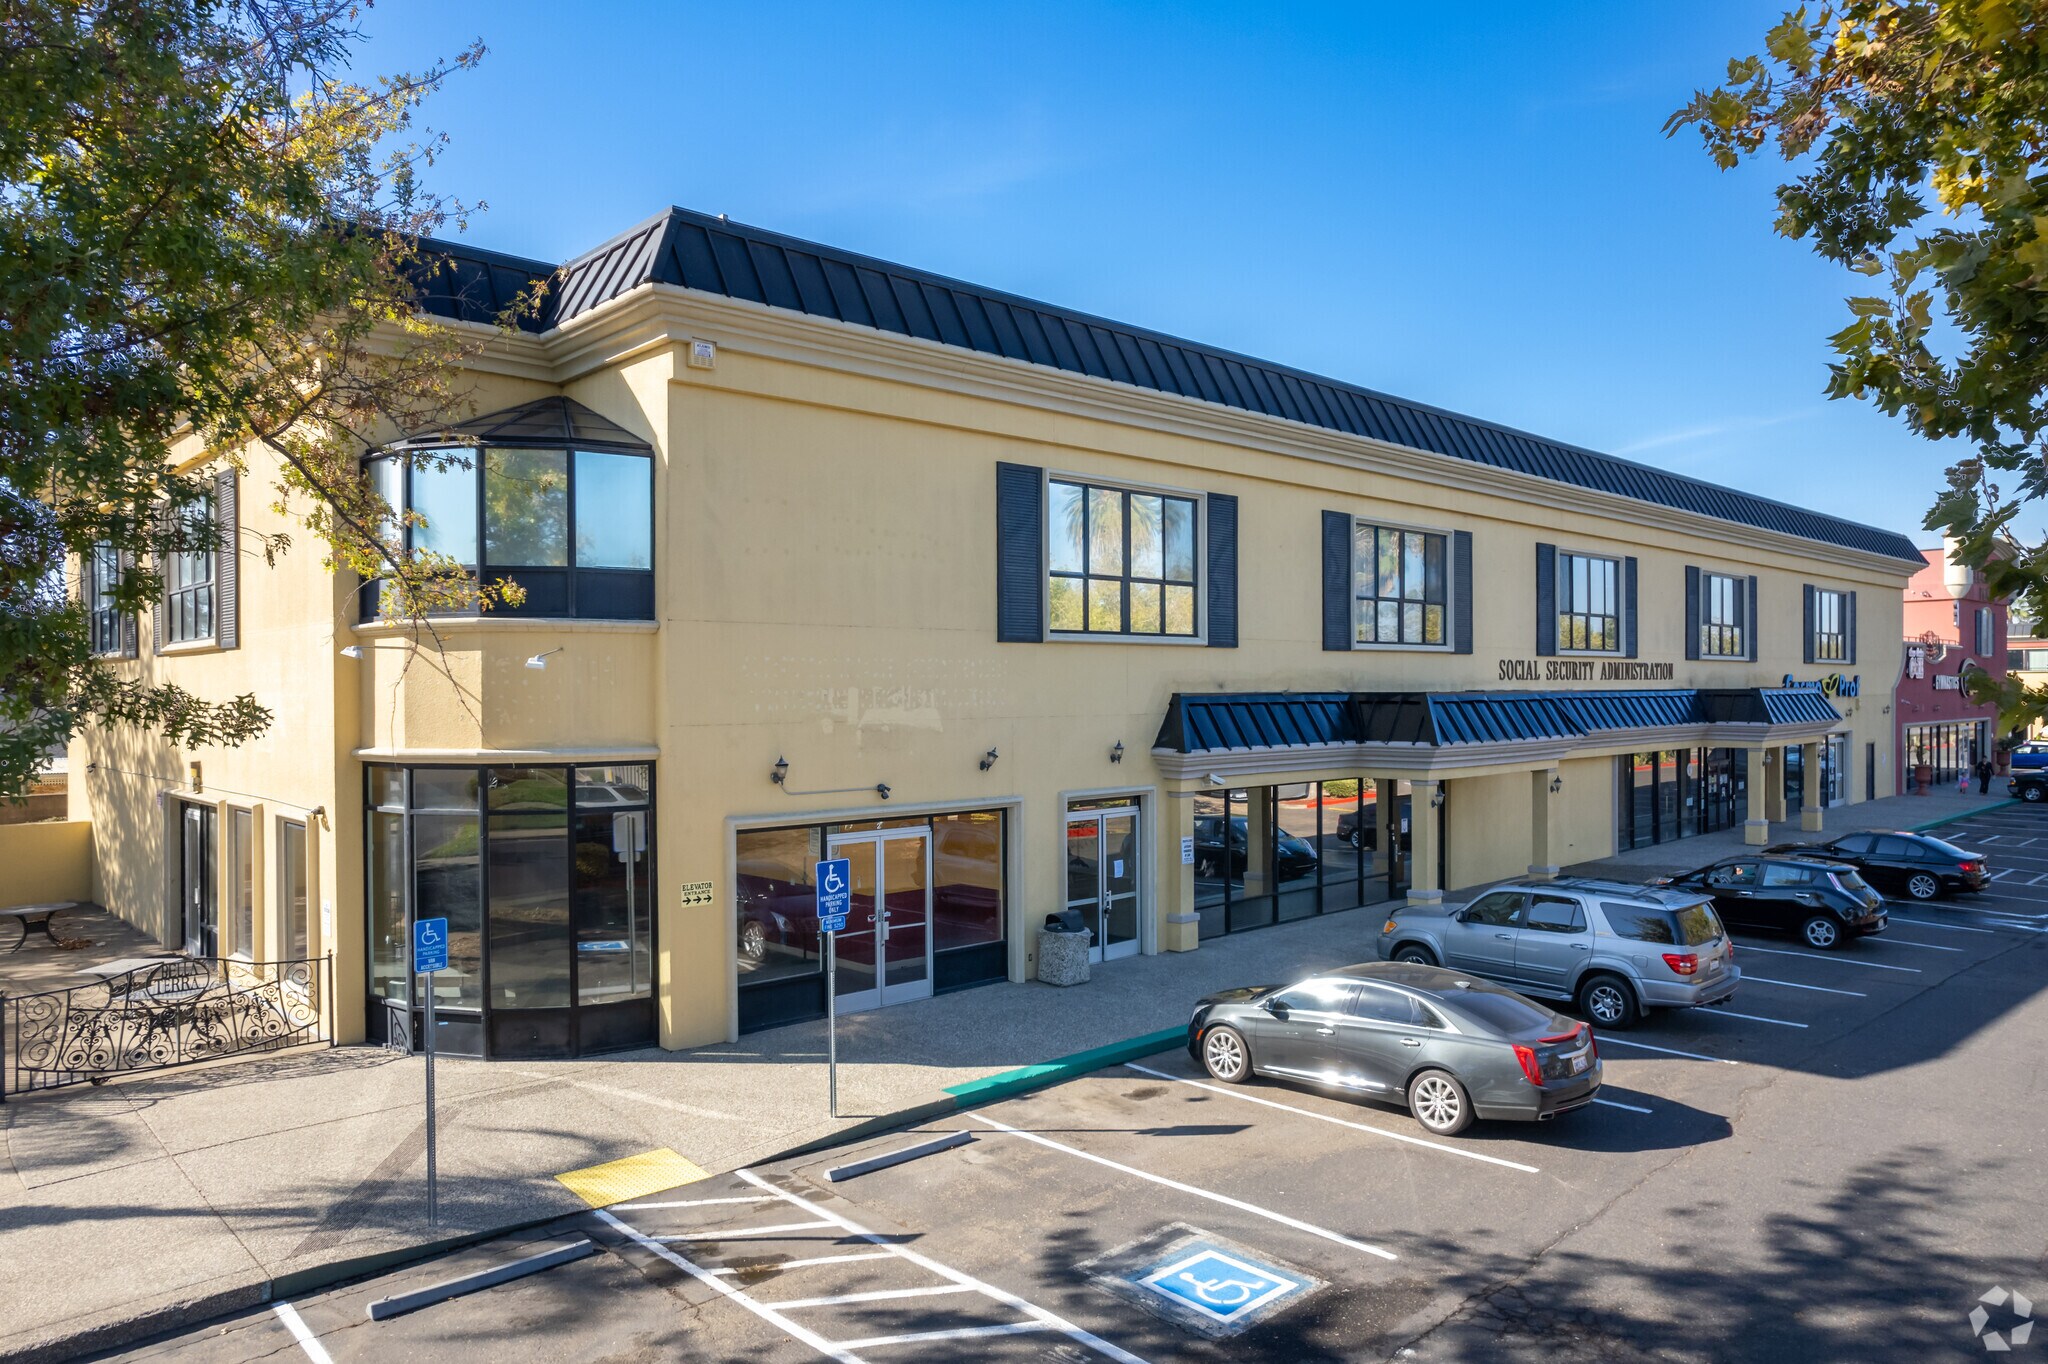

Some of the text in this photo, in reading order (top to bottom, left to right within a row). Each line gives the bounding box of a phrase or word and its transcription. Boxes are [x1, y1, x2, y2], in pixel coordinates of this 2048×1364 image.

[1499, 659, 1674, 681] SOCIAL SECURITY ADMINISTRATION
[1837, 674, 1860, 697] Prof
[682, 881, 712, 891] ELEVATOR
[820, 892, 848, 902] HANDICAPPED
[825, 899, 842, 907] PARKING
[828, 906, 839, 914] ONLY
[161, 961, 198, 979] BELLA
[153, 976, 199, 994] TERRA
